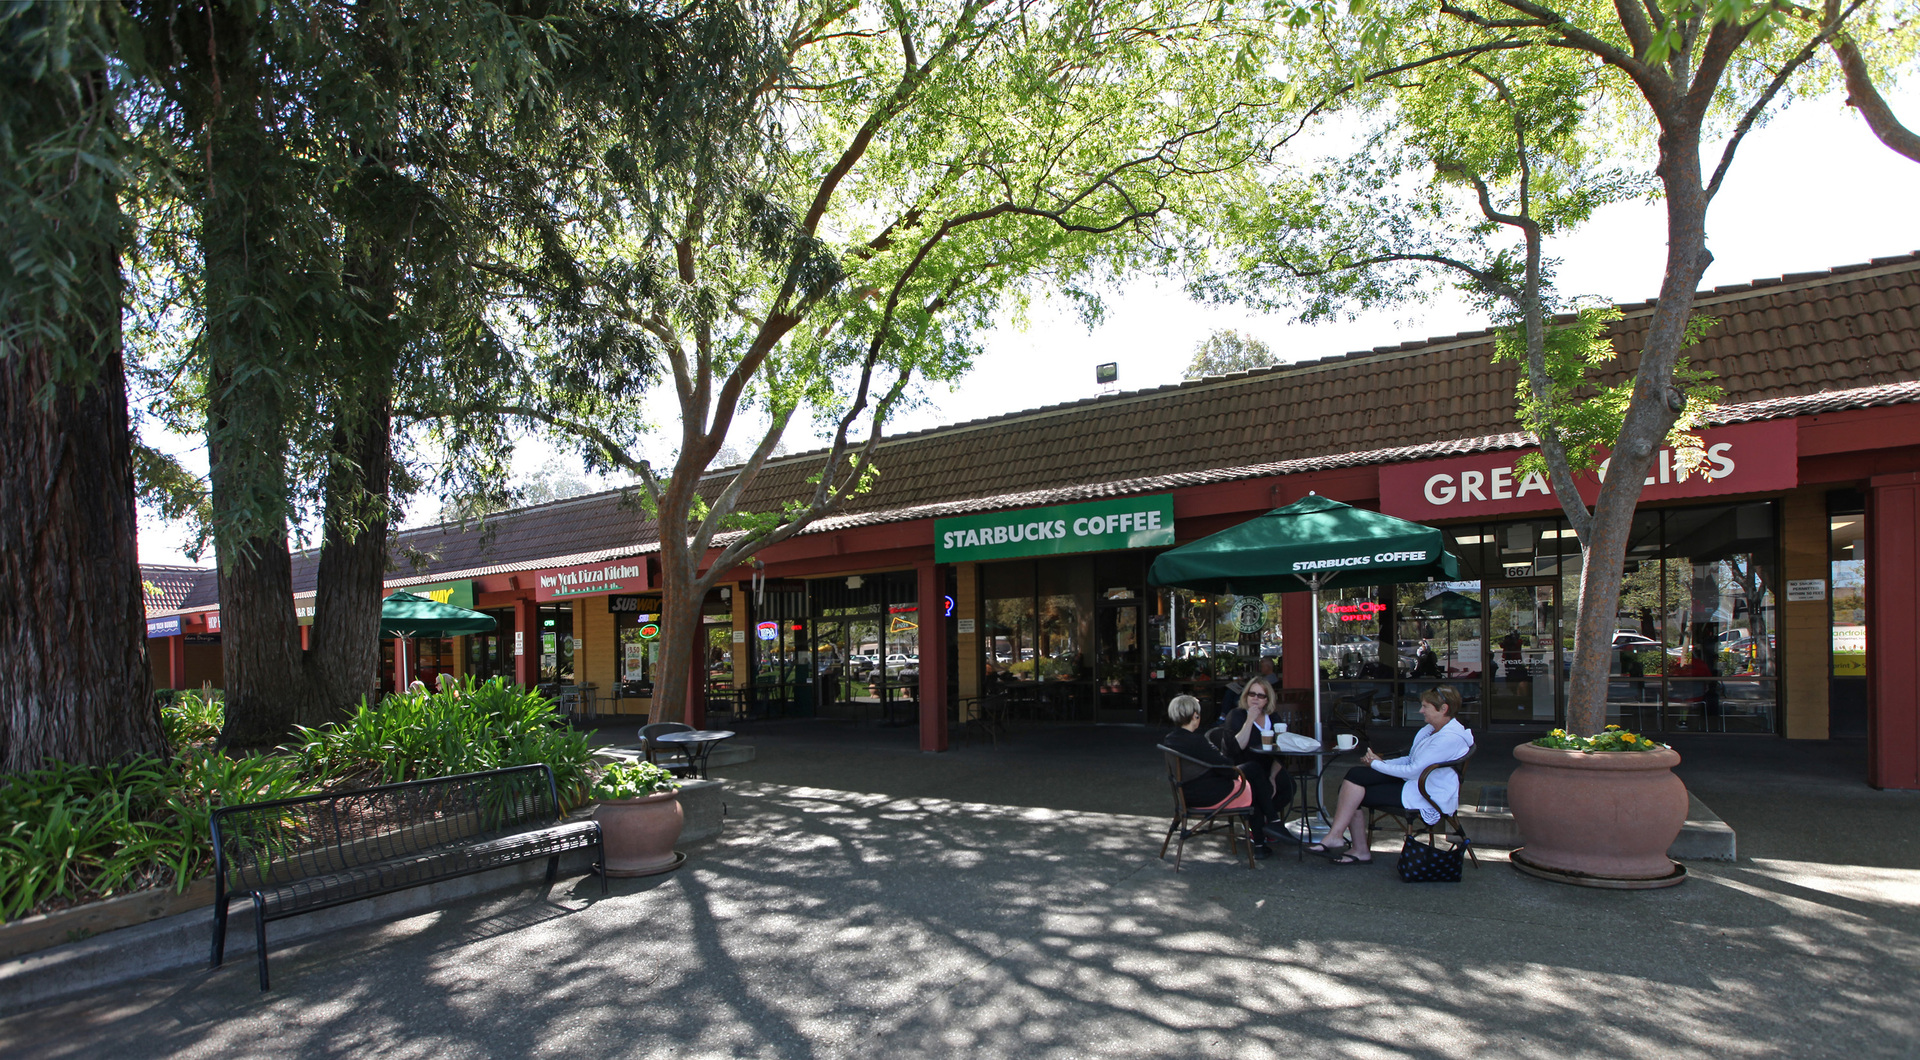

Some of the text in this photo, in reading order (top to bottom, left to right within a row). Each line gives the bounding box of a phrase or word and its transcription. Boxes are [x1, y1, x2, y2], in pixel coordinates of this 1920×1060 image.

[1424, 466, 1552, 505] GREA
[943, 511, 1161, 549] STARBUCKS COFFEE
[1292, 551, 1426, 571] STARBUCKS COFFEE
[541, 565, 639, 588] New York Pizza Kitchen
[1508, 567, 1531, 577] 667
[612, 597, 661, 611] SUBWAY
[1326, 602, 1386, 614] Great Clips
[1341, 614, 1372, 622] OPEN
[641, 627, 656, 635] OPEN
